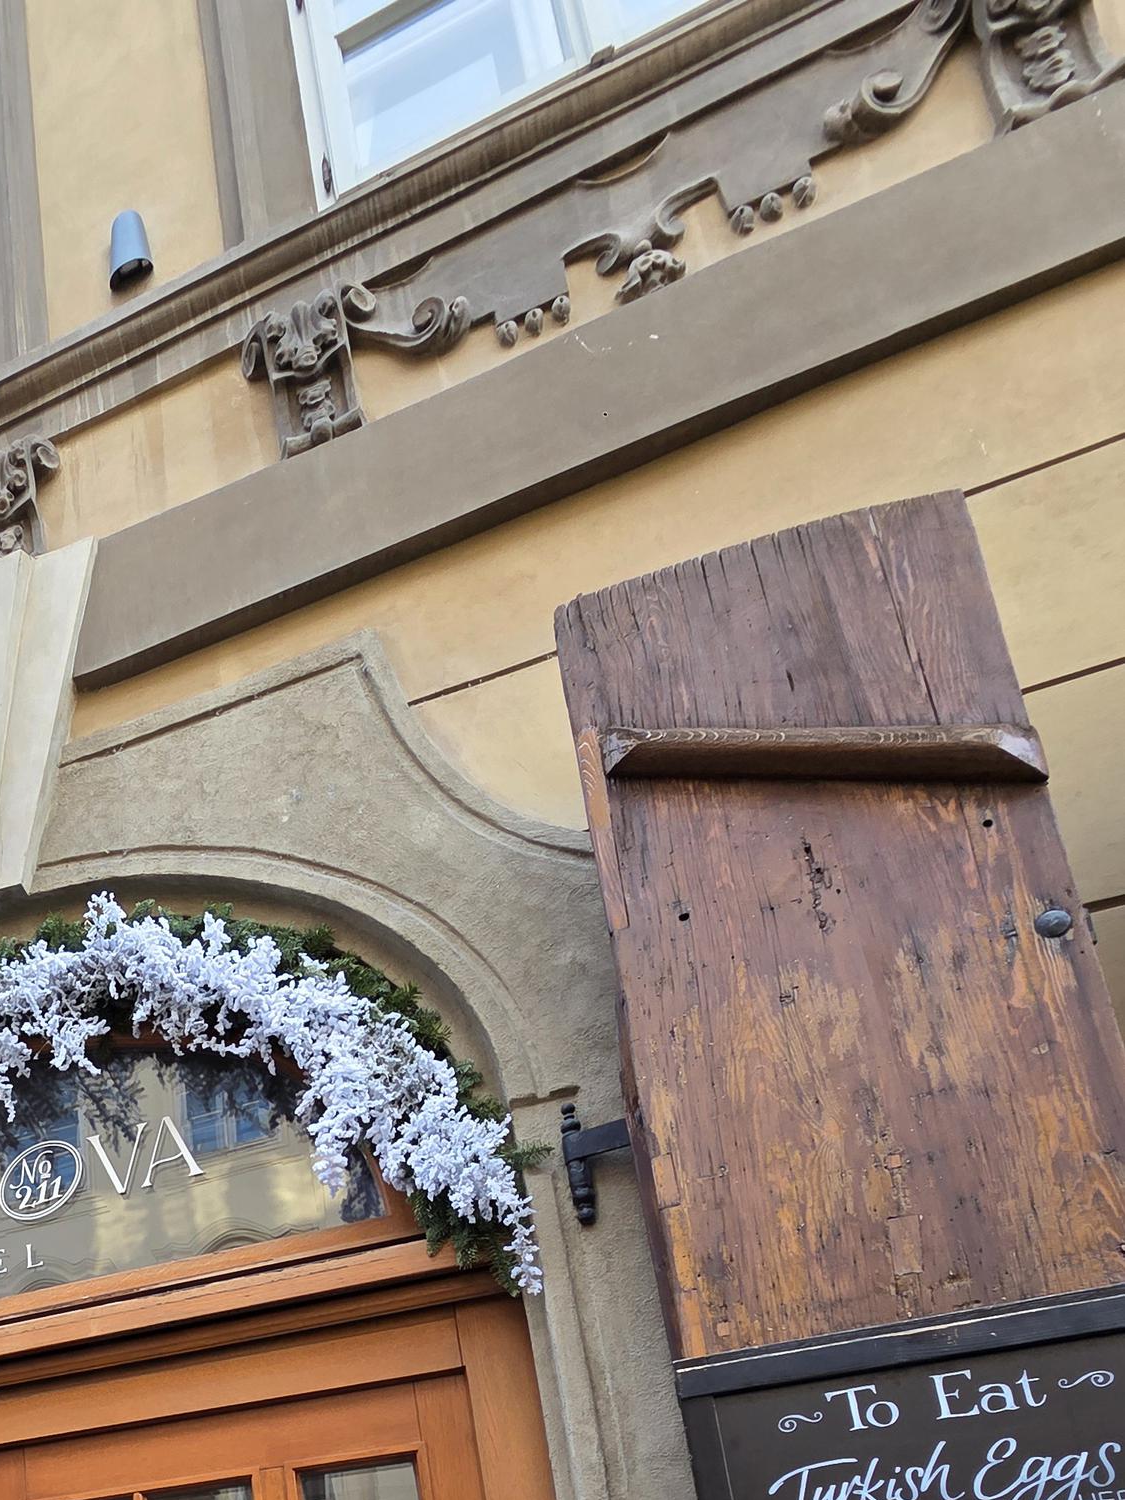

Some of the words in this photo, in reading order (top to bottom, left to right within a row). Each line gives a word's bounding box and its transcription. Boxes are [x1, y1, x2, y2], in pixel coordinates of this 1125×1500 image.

[15, 1175, 63, 1210] 211
[824, 1384, 900, 1432] To
[928, 1368, 1048, 1421] Eat
